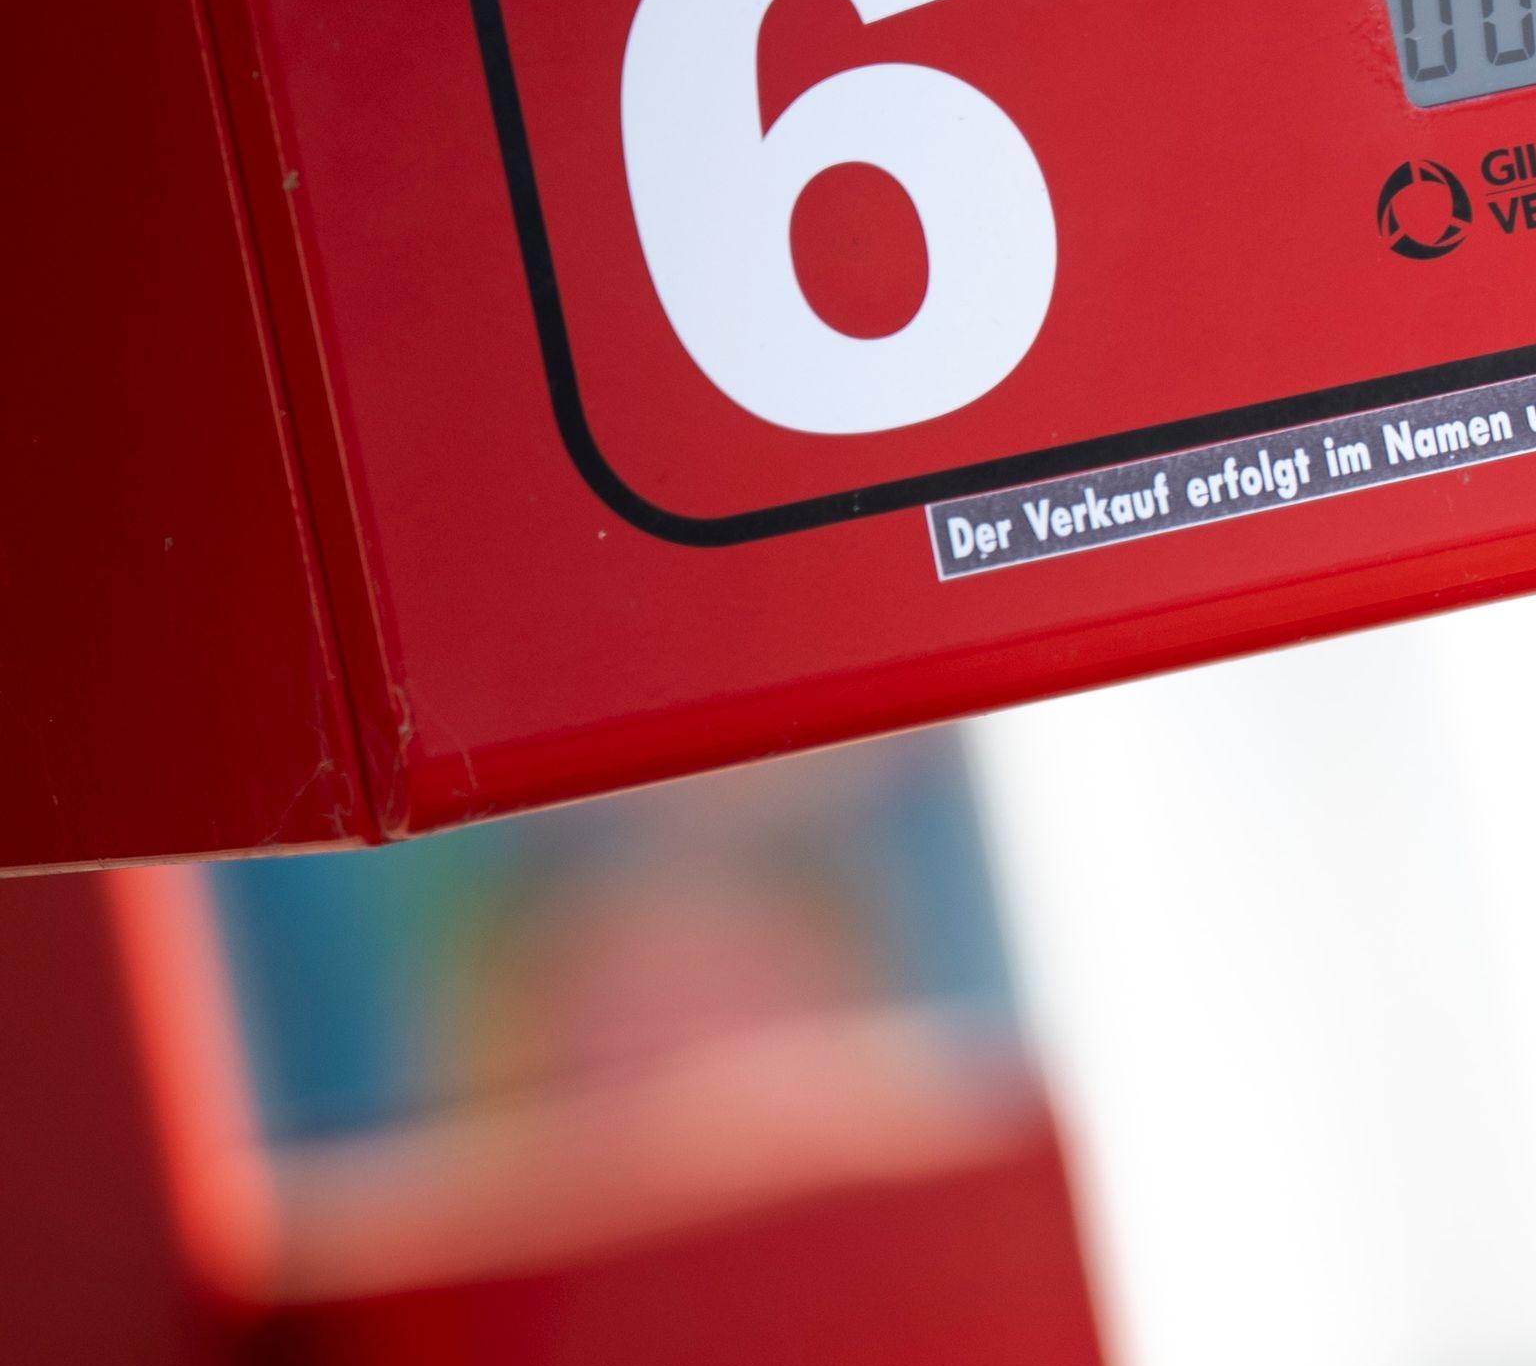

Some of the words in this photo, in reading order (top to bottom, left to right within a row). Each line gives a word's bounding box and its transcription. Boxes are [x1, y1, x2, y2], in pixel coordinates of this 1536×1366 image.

[947, 515, 1012, 560] Der
[1022, 474, 1172, 542] Verkauf
[1186, 444, 1312, 507] erfolgt
[1324, 435, 1372, 478] im
[1381, 410, 1514, 467] Namen
